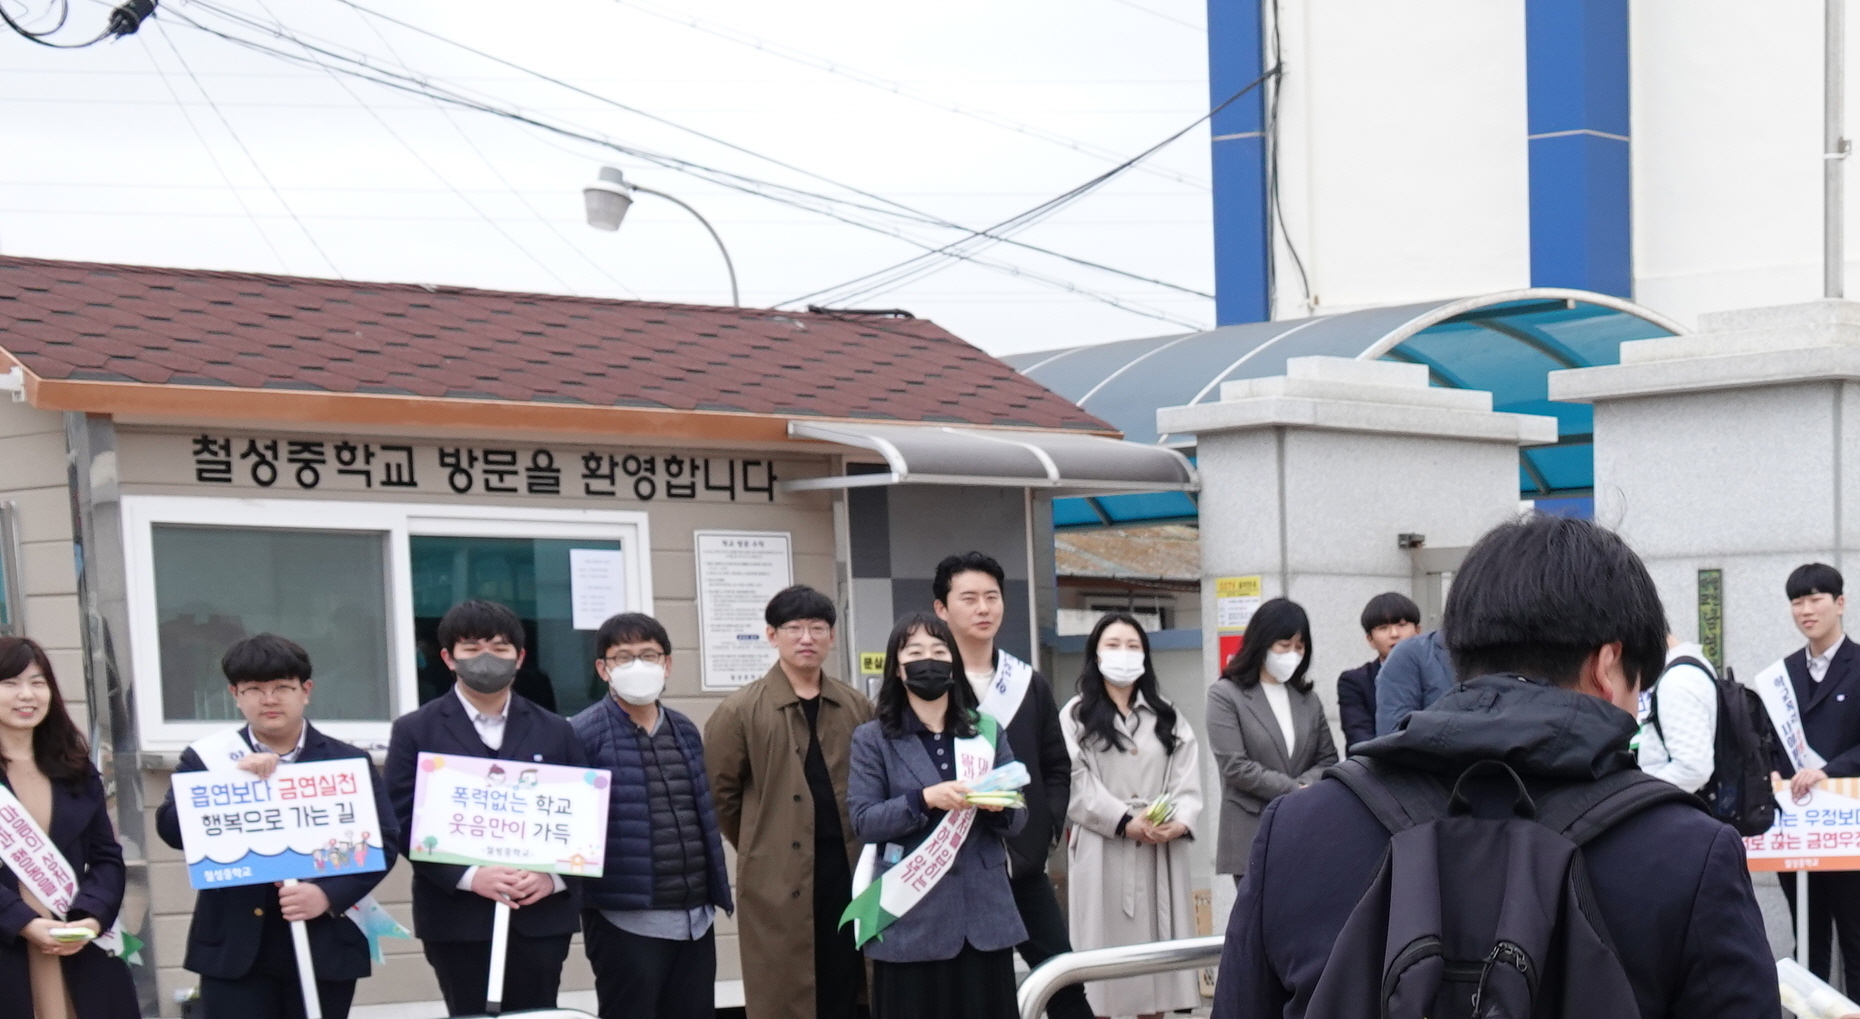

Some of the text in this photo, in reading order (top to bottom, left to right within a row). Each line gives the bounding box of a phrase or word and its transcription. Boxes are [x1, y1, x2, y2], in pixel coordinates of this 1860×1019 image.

[192, 434, 778, 501] 철성중학교 방문을 환영합니다
[190, 773, 358, 808] 흡연보다 금연실천
[451, 786, 572, 816] 폭력없는 학교
[201, 802, 355, 836] 행복으로 가는 길
[449, 813, 570, 845] 웃음만이 가득
[925, 828, 950, 857] 하지
[1771, 833, 1802, 850] 끊는
[900, 854, 925, 884] 않기
[911, 848, 954, 892] 입히는
